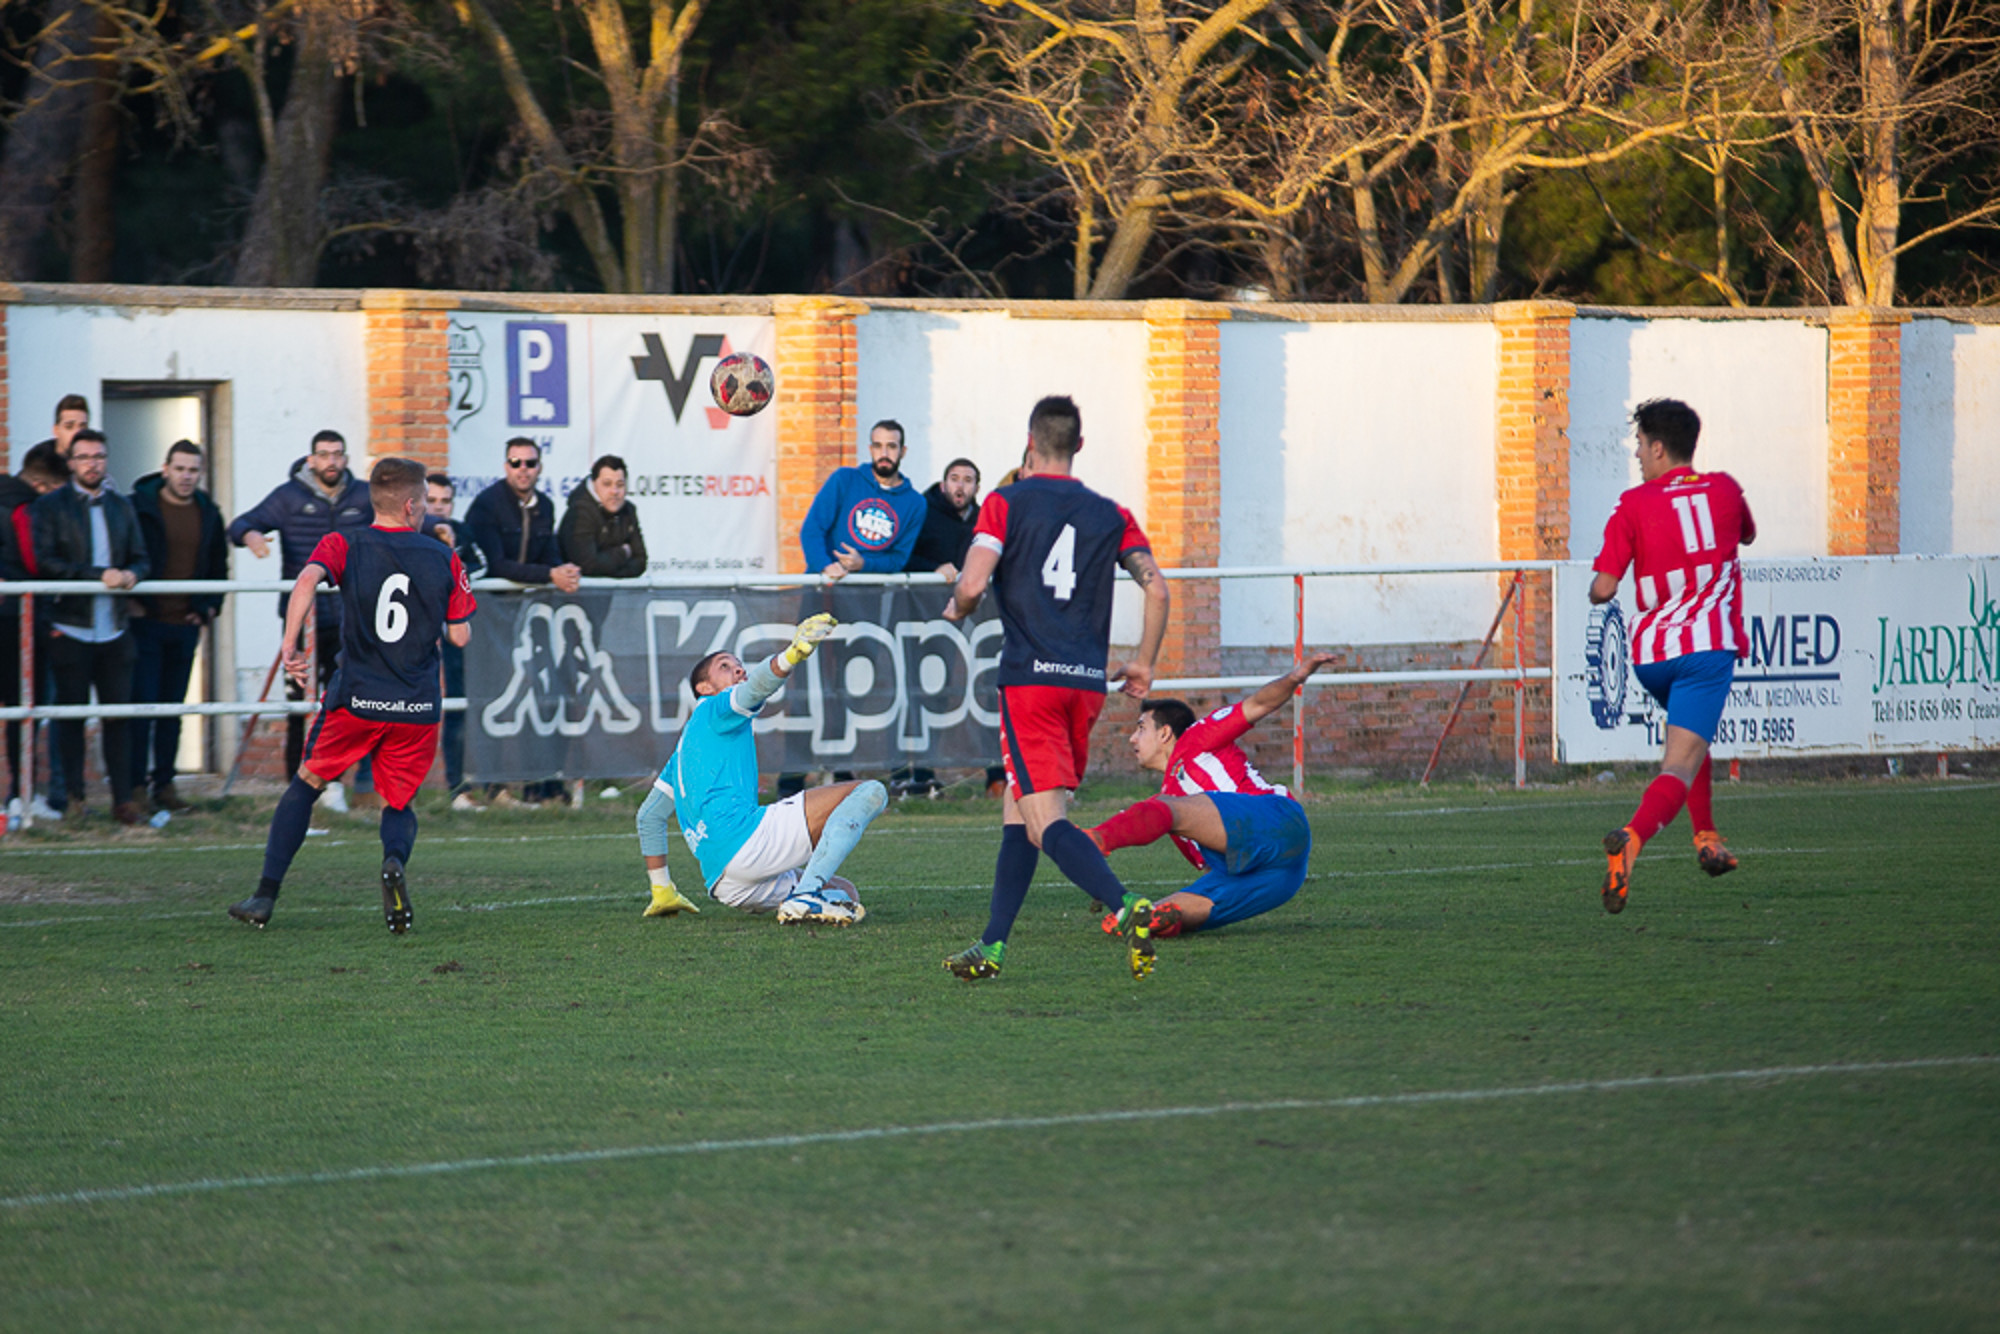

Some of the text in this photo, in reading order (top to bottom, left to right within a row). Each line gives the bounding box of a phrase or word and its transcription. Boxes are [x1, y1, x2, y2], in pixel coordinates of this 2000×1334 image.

[447, 371, 473, 410] 2
[1671, 492, 1716, 554] 11
[1041, 523, 1076, 600] 4
[375, 573, 410, 643] 6
[1738, 613, 1840, 668] MED
